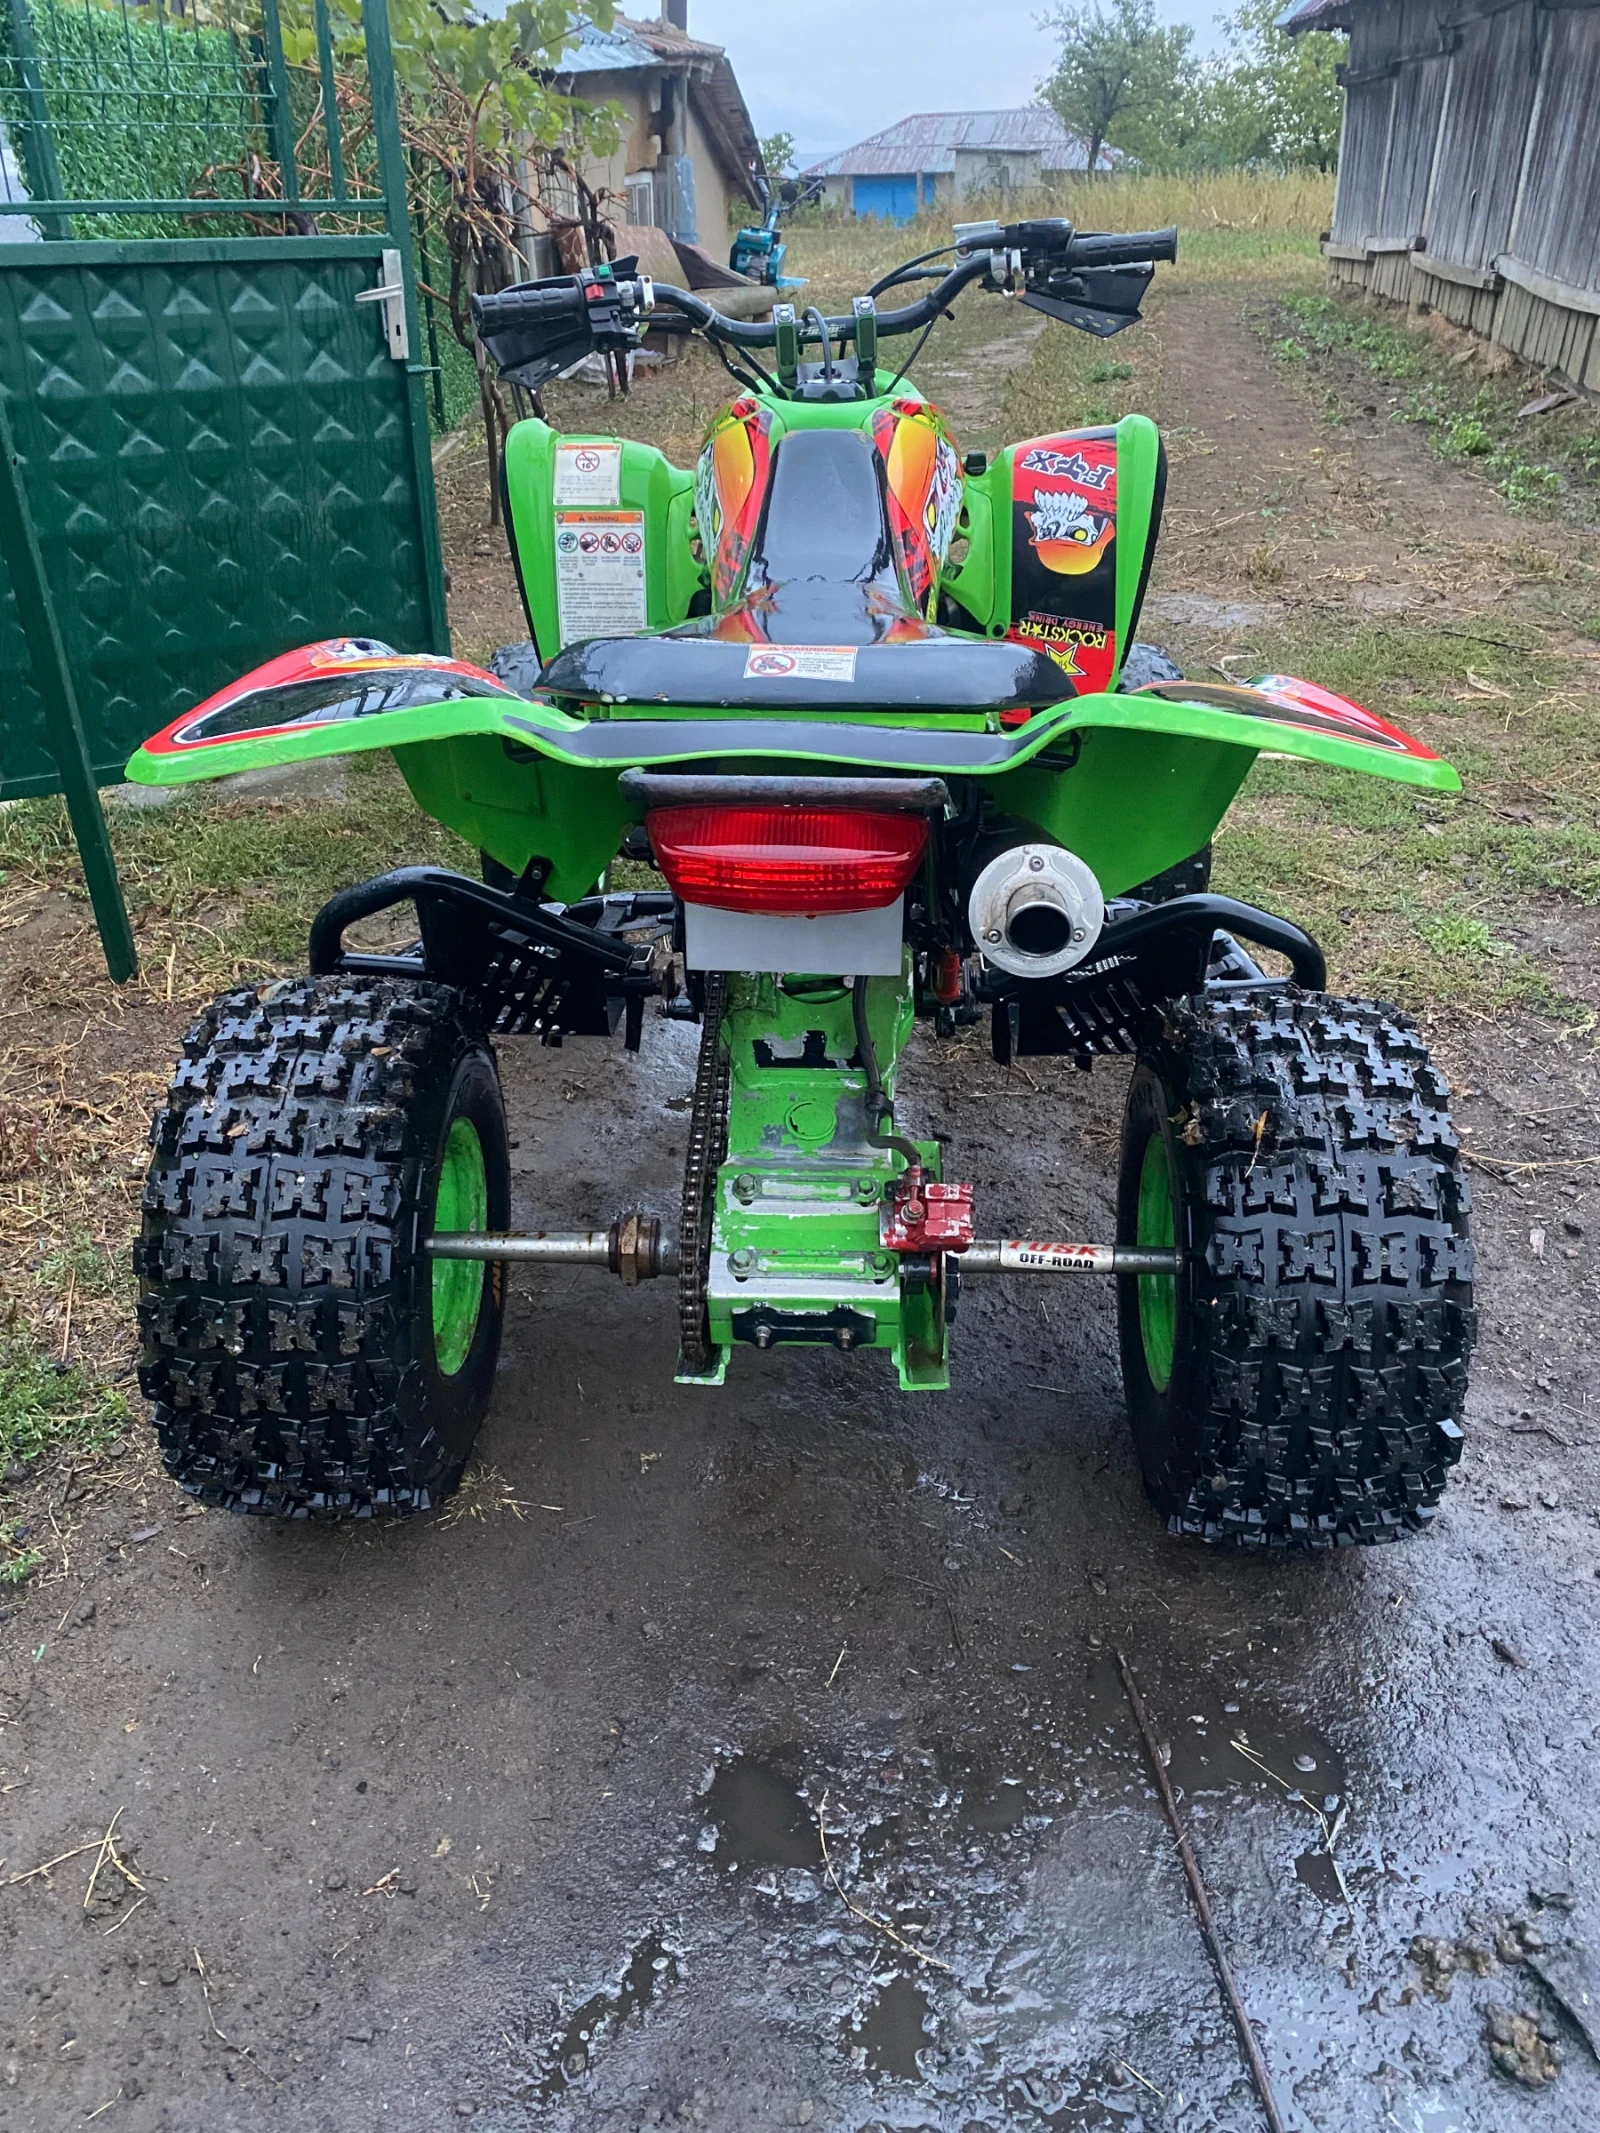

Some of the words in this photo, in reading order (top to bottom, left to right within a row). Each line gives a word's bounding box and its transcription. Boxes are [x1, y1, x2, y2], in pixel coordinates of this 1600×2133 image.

[1028, 612, 1059, 625] DRINK
[1062, 620, 1103, 632] ENERGY
[1009, 1240, 1101, 1258] TUSK
[1019, 1252, 1095, 1269] OFF-ROAD
